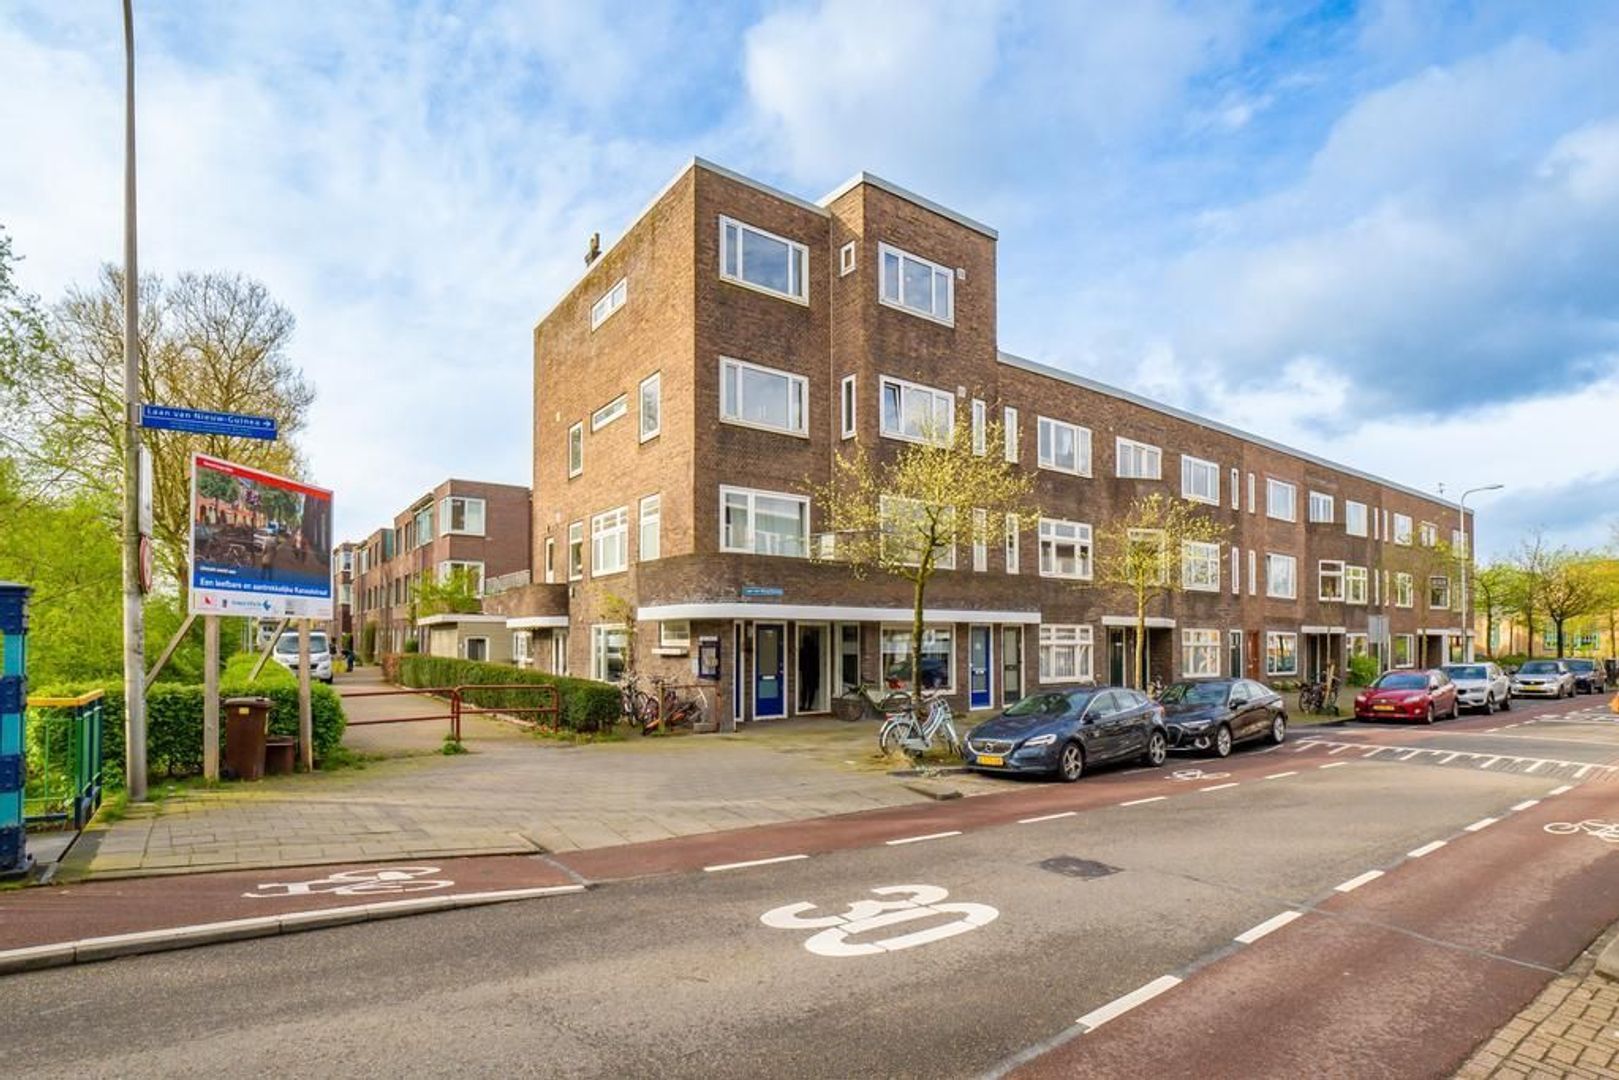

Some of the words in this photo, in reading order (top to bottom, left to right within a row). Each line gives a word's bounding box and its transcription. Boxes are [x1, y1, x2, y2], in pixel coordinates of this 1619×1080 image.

[147, 408, 171, 416] Laan
[173, 411, 191, 419] van
[194, 412, 260, 426] Nieuw-Guinea
[200, 577, 214, 587] Een
[760, 884, 999, 956] 30
